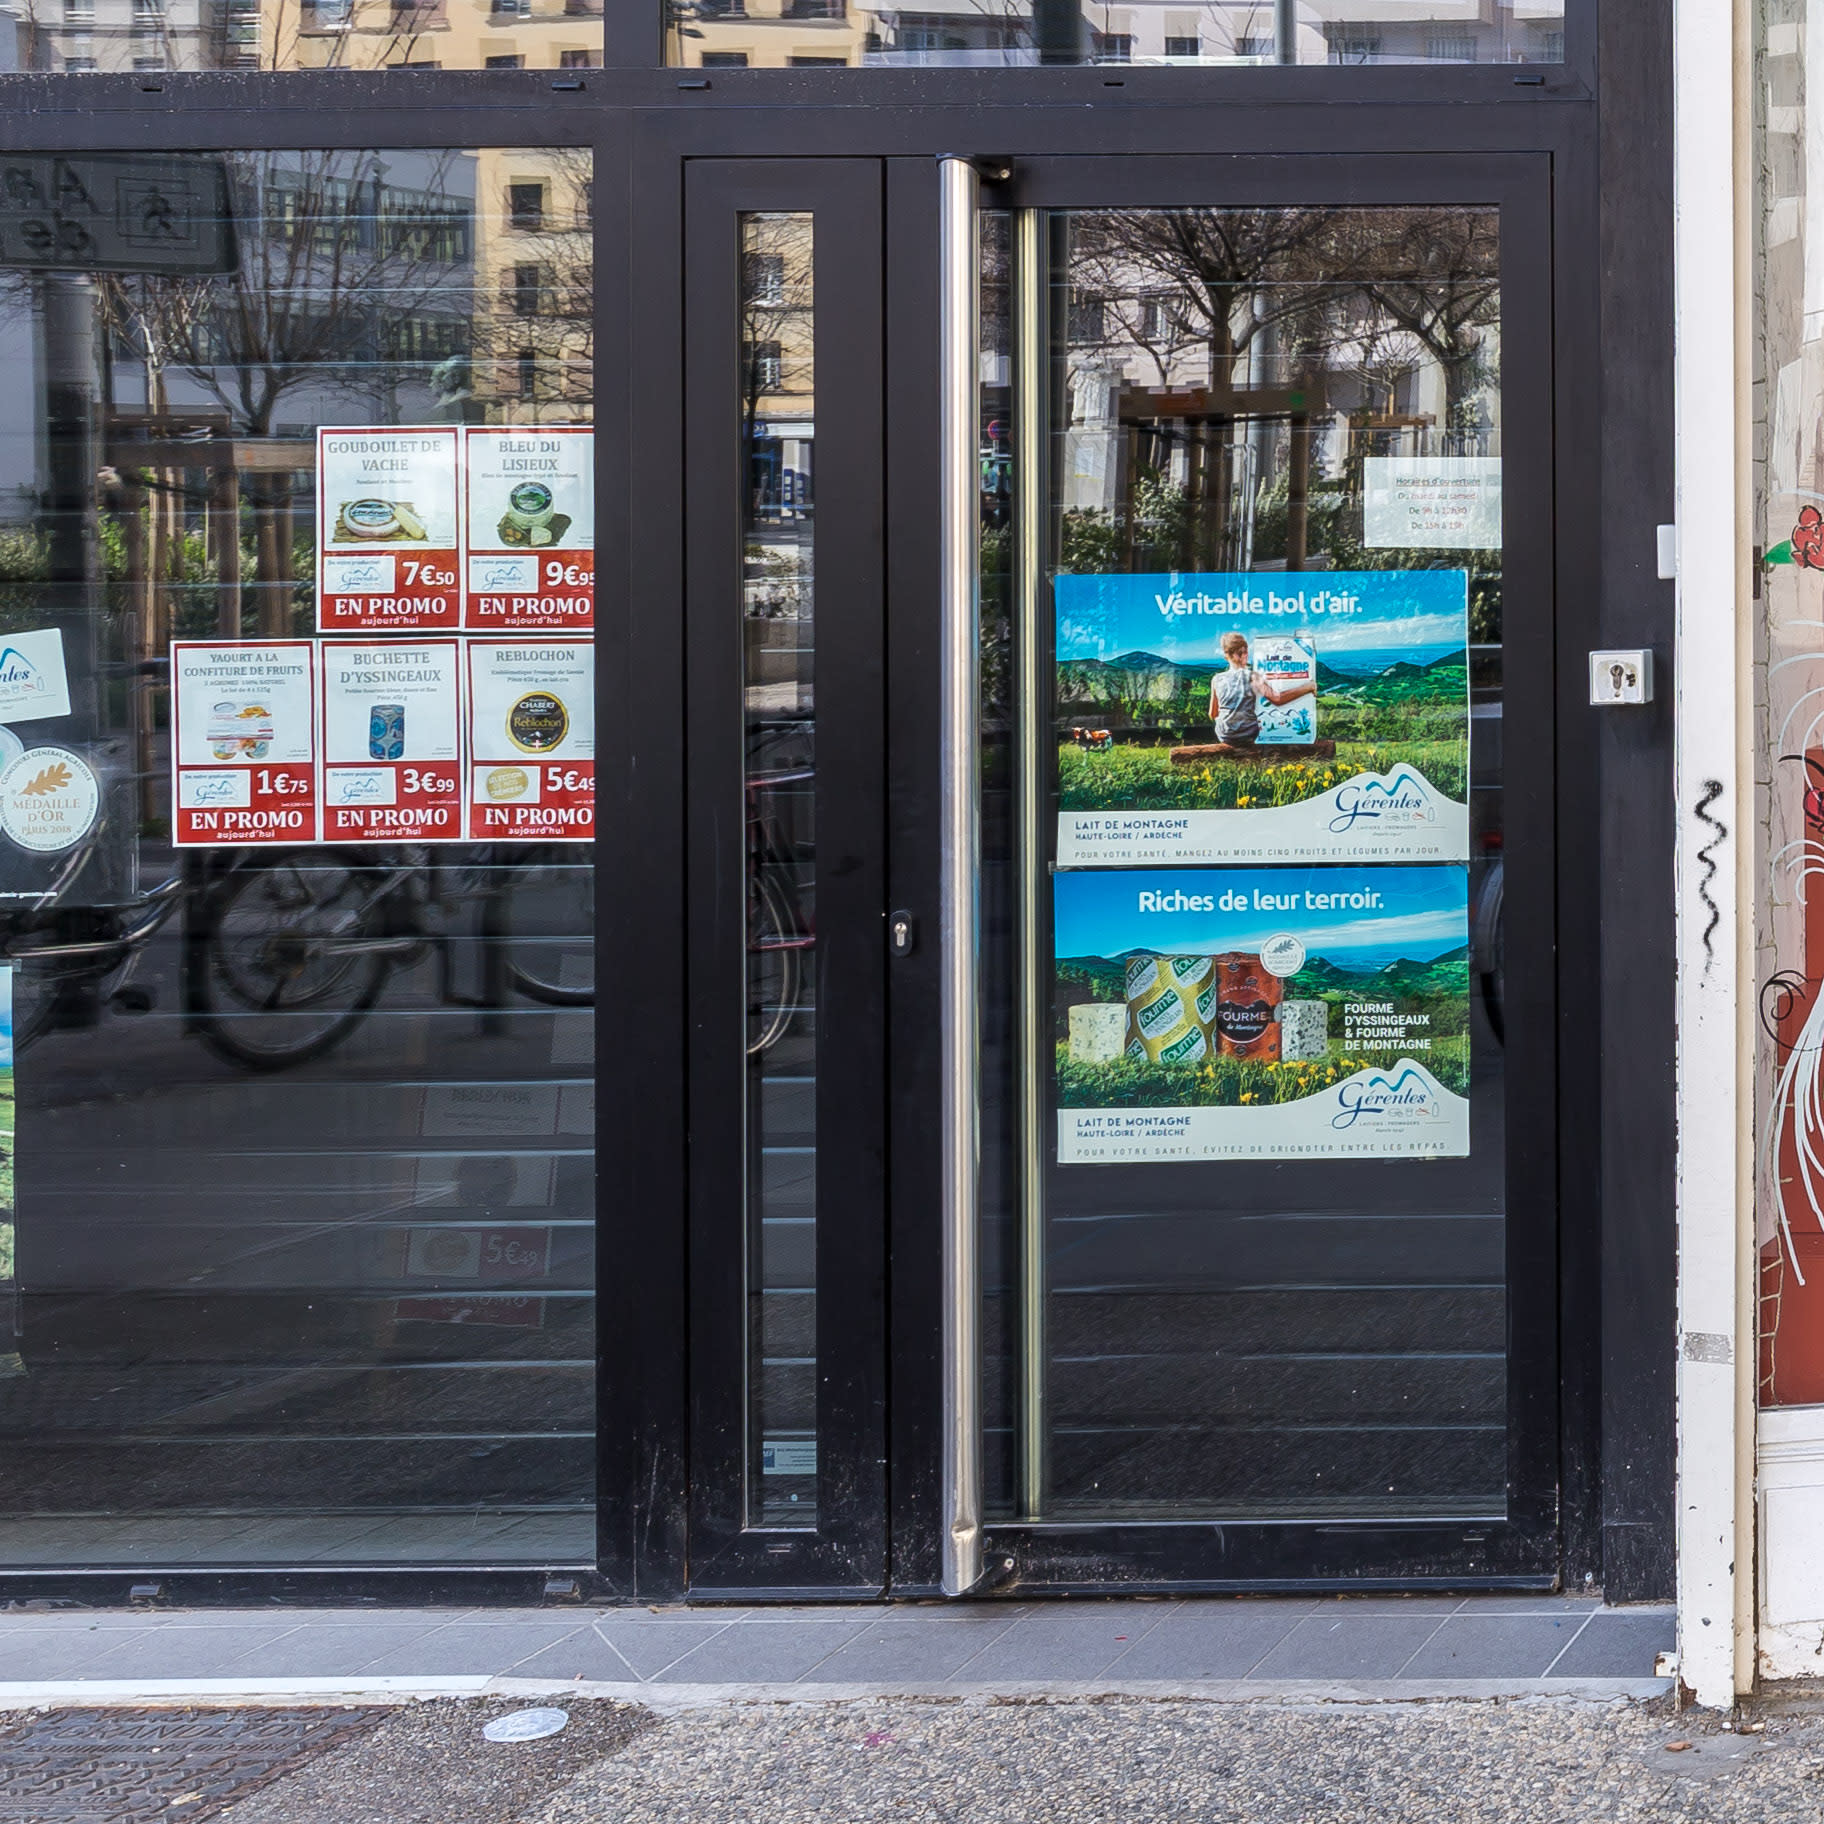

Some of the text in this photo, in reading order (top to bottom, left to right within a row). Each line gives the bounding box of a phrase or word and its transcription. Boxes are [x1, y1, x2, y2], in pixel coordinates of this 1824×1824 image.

[327, 440, 441, 455] GOUDOULET DE
[499, 440, 561, 453] BLEU DU
[361, 458, 409, 472] VACHE
[502, 458, 559, 472] LISIEUX
[403, 561, 455, 587] 7€50
[335, 597, 447, 615] EN PROMO
[479, 597, 591, 615] EN PROMO
[1155, 591, 1363, 617] Véritable bol d'air.
[210, 653, 252, 664] YAOURT
[266, 653, 279, 662] LA
[496, 650, 576, 662] REBLOCHON
[184, 664, 304, 677] CONFITURE DE FRUITS
[340, 670, 442, 684] D'YSSINGEAUX
[257, 769, 308, 794] 1€75
[403, 768, 455, 794] 3€99
[13, 796, 81, 810] MÉDAILLE
[1329, 785, 1422, 834] Gérentes
[28, 809, 65, 823] D'OR
[191, 810, 303, 830] EN PROMO
[336, 809, 449, 828] EN PROMO
[485, 807, 593, 826] EN PROMO
[1075, 819, 1189, 830] LAIT DE MONTAGNE
[1075, 832, 1132, 841] HAUTE-LOIRE
[1138, 886, 1384, 913] Riches de leur terroir.
[1344, 1002, 1394, 1014] FOURME
[1344, 1014, 1430, 1027] D'YSSINGEAUX
[1344, 1026, 1406, 1038] & FOURME
[1345, 1038, 1432, 1051] DE MONTAGNE
[1332, 1081, 1427, 1130] Gérentes
[1077, 1116, 1192, 1127] LAIT DE MONTAGNE
[1077, 1129, 1135, 1138] HAUTE-LOIRE
